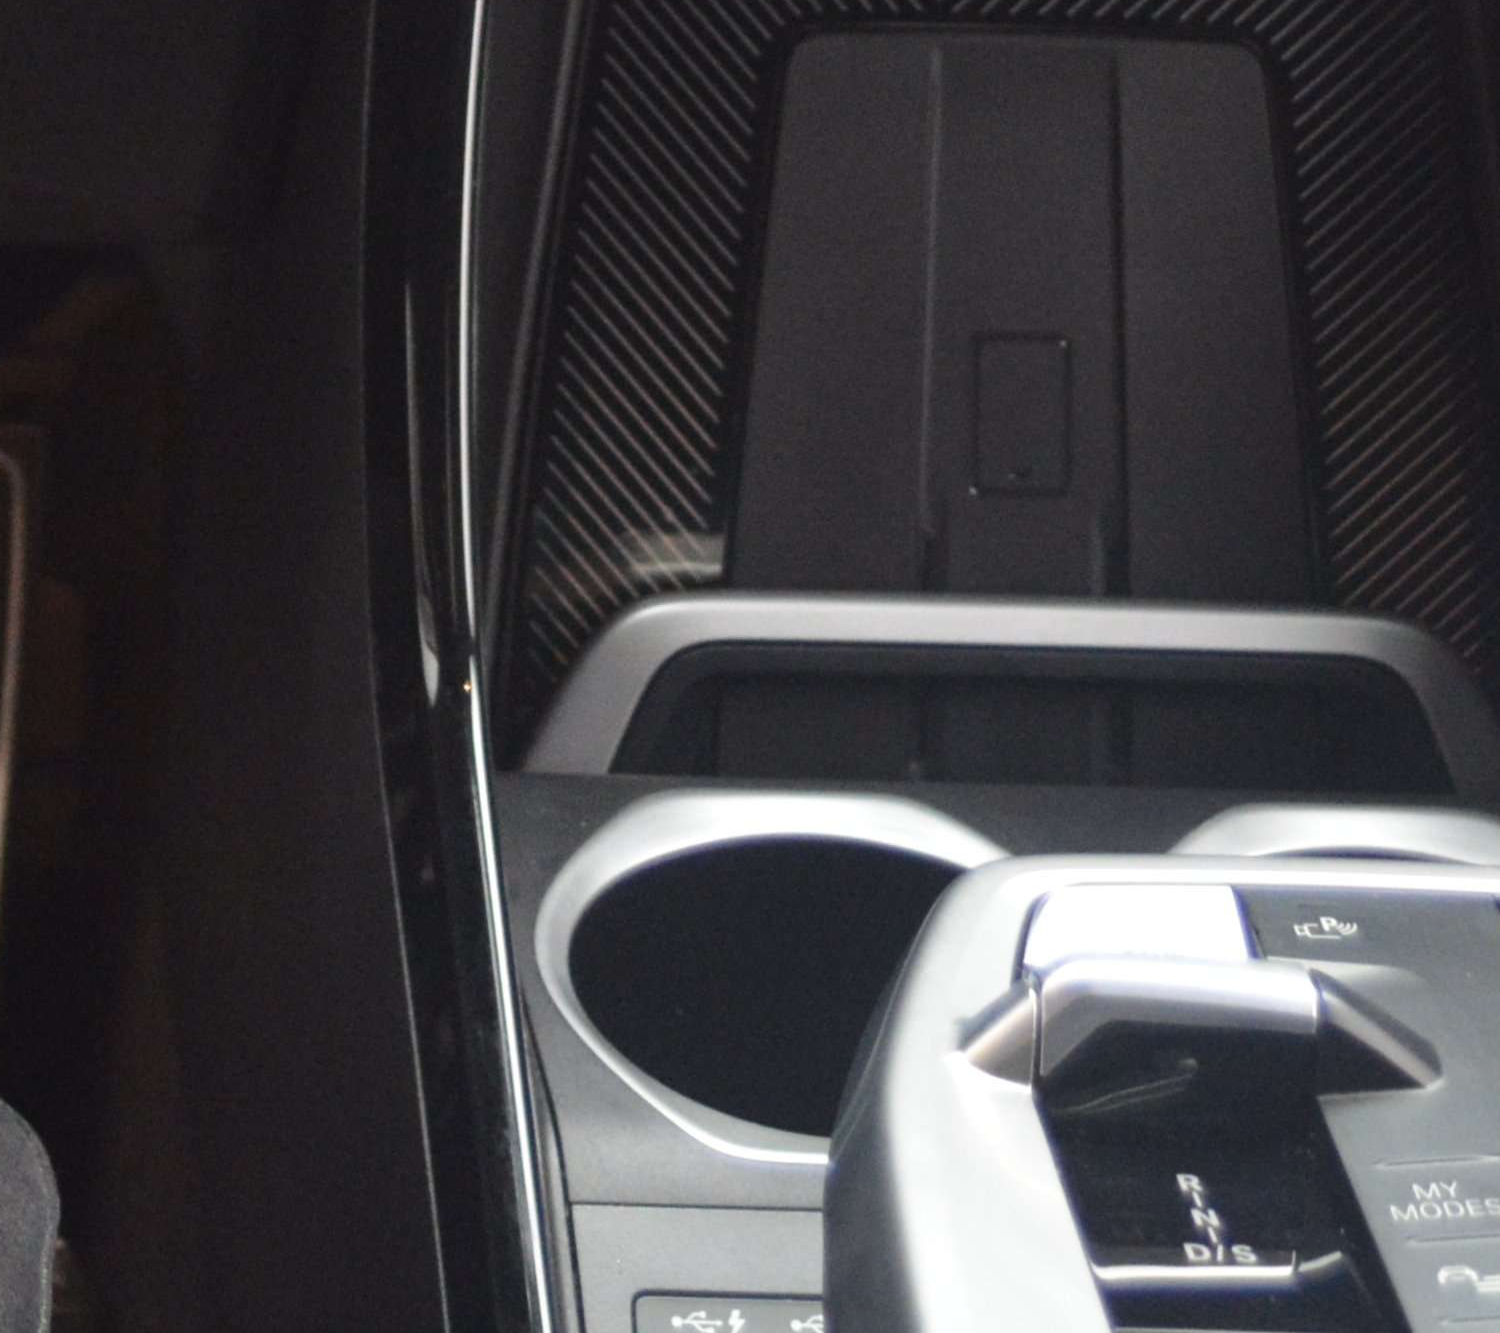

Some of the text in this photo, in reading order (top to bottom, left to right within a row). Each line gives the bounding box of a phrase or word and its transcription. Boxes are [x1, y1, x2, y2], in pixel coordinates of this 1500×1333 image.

[1175, 1173, 1204, 1194] R
[1412, 1180, 1460, 1200] MY
[1190, 1208, 1222, 1229] N
